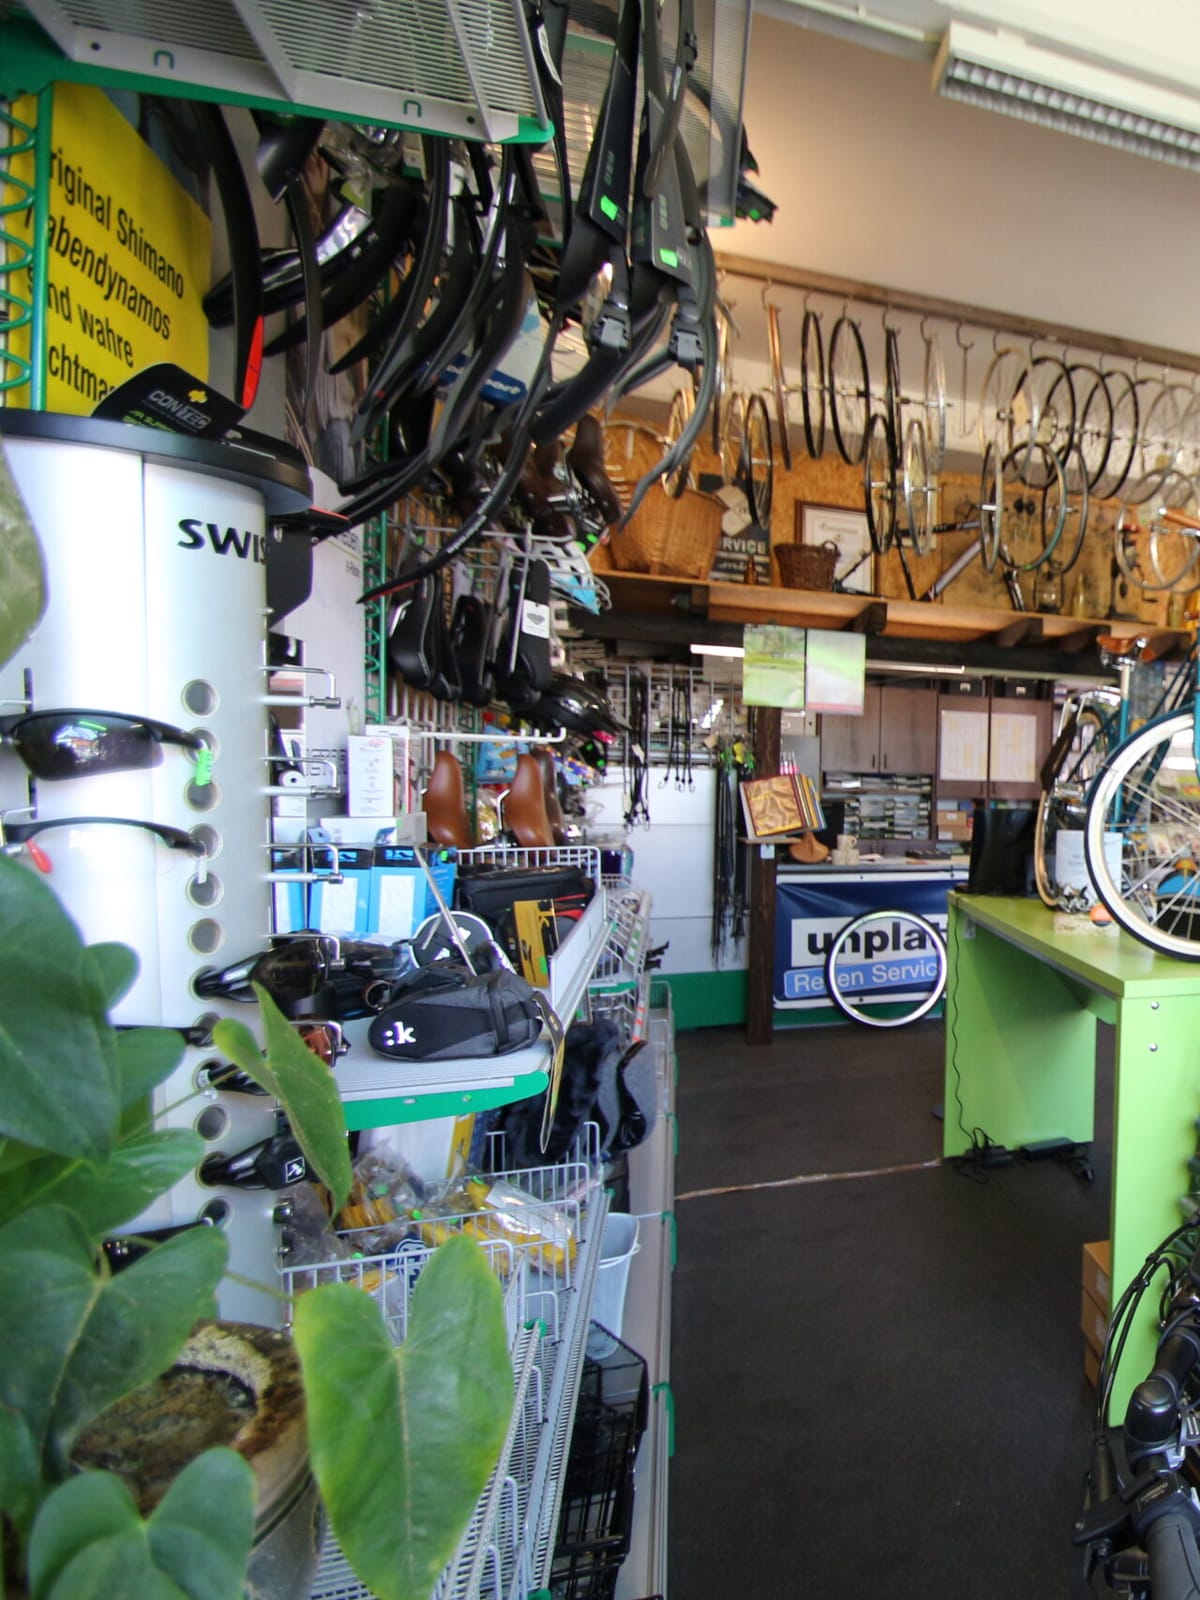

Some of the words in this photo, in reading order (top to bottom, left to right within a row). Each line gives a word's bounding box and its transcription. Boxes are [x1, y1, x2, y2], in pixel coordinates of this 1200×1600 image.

[49, 148, 112, 232] riginal
[116, 207, 185, 300] Shimano
[39, 215, 171, 341] abendynamos
[78, 303, 134, 369] wahre
[794, 970, 865, 993] Reen
[872, 959, 938, 983] Servic
